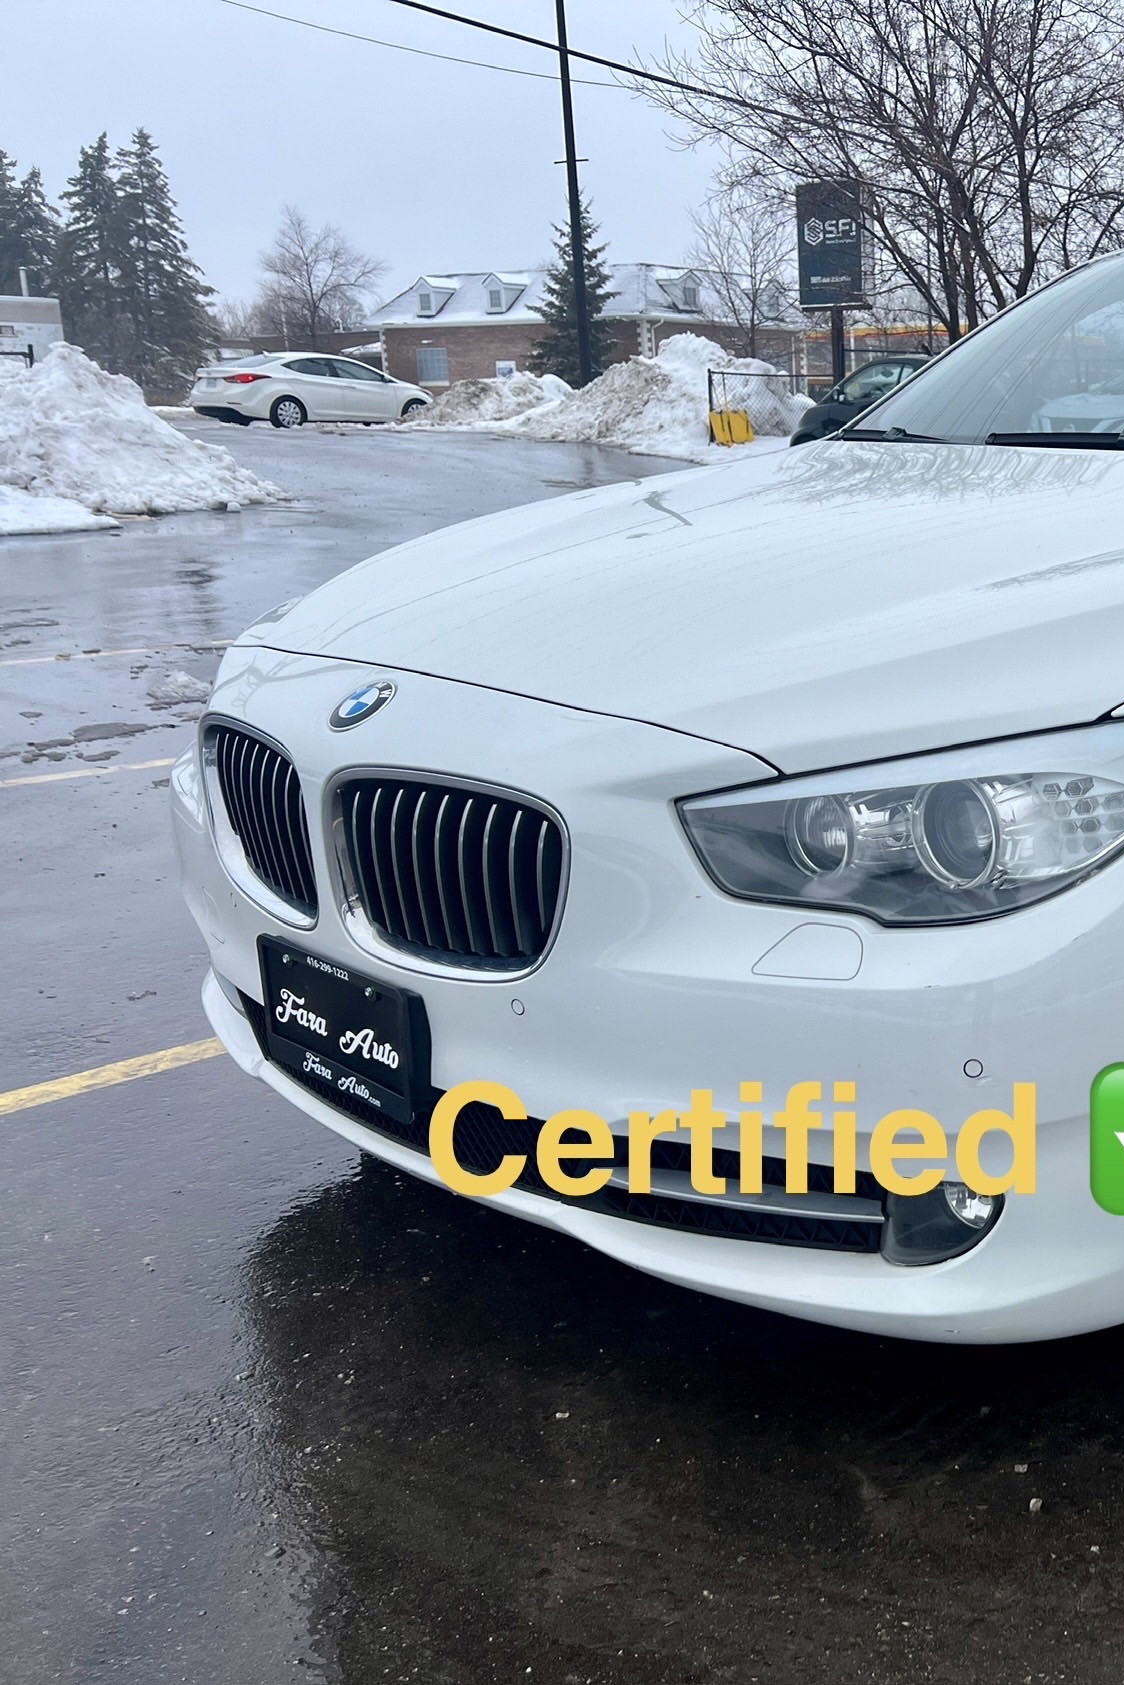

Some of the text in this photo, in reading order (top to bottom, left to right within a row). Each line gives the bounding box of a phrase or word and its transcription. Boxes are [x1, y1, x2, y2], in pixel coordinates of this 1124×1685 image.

[306, 956, 349, 981] 416-299-1222
[275, 988, 399, 1069] Fara Auto
[303, 1051, 332, 1081] Fara
